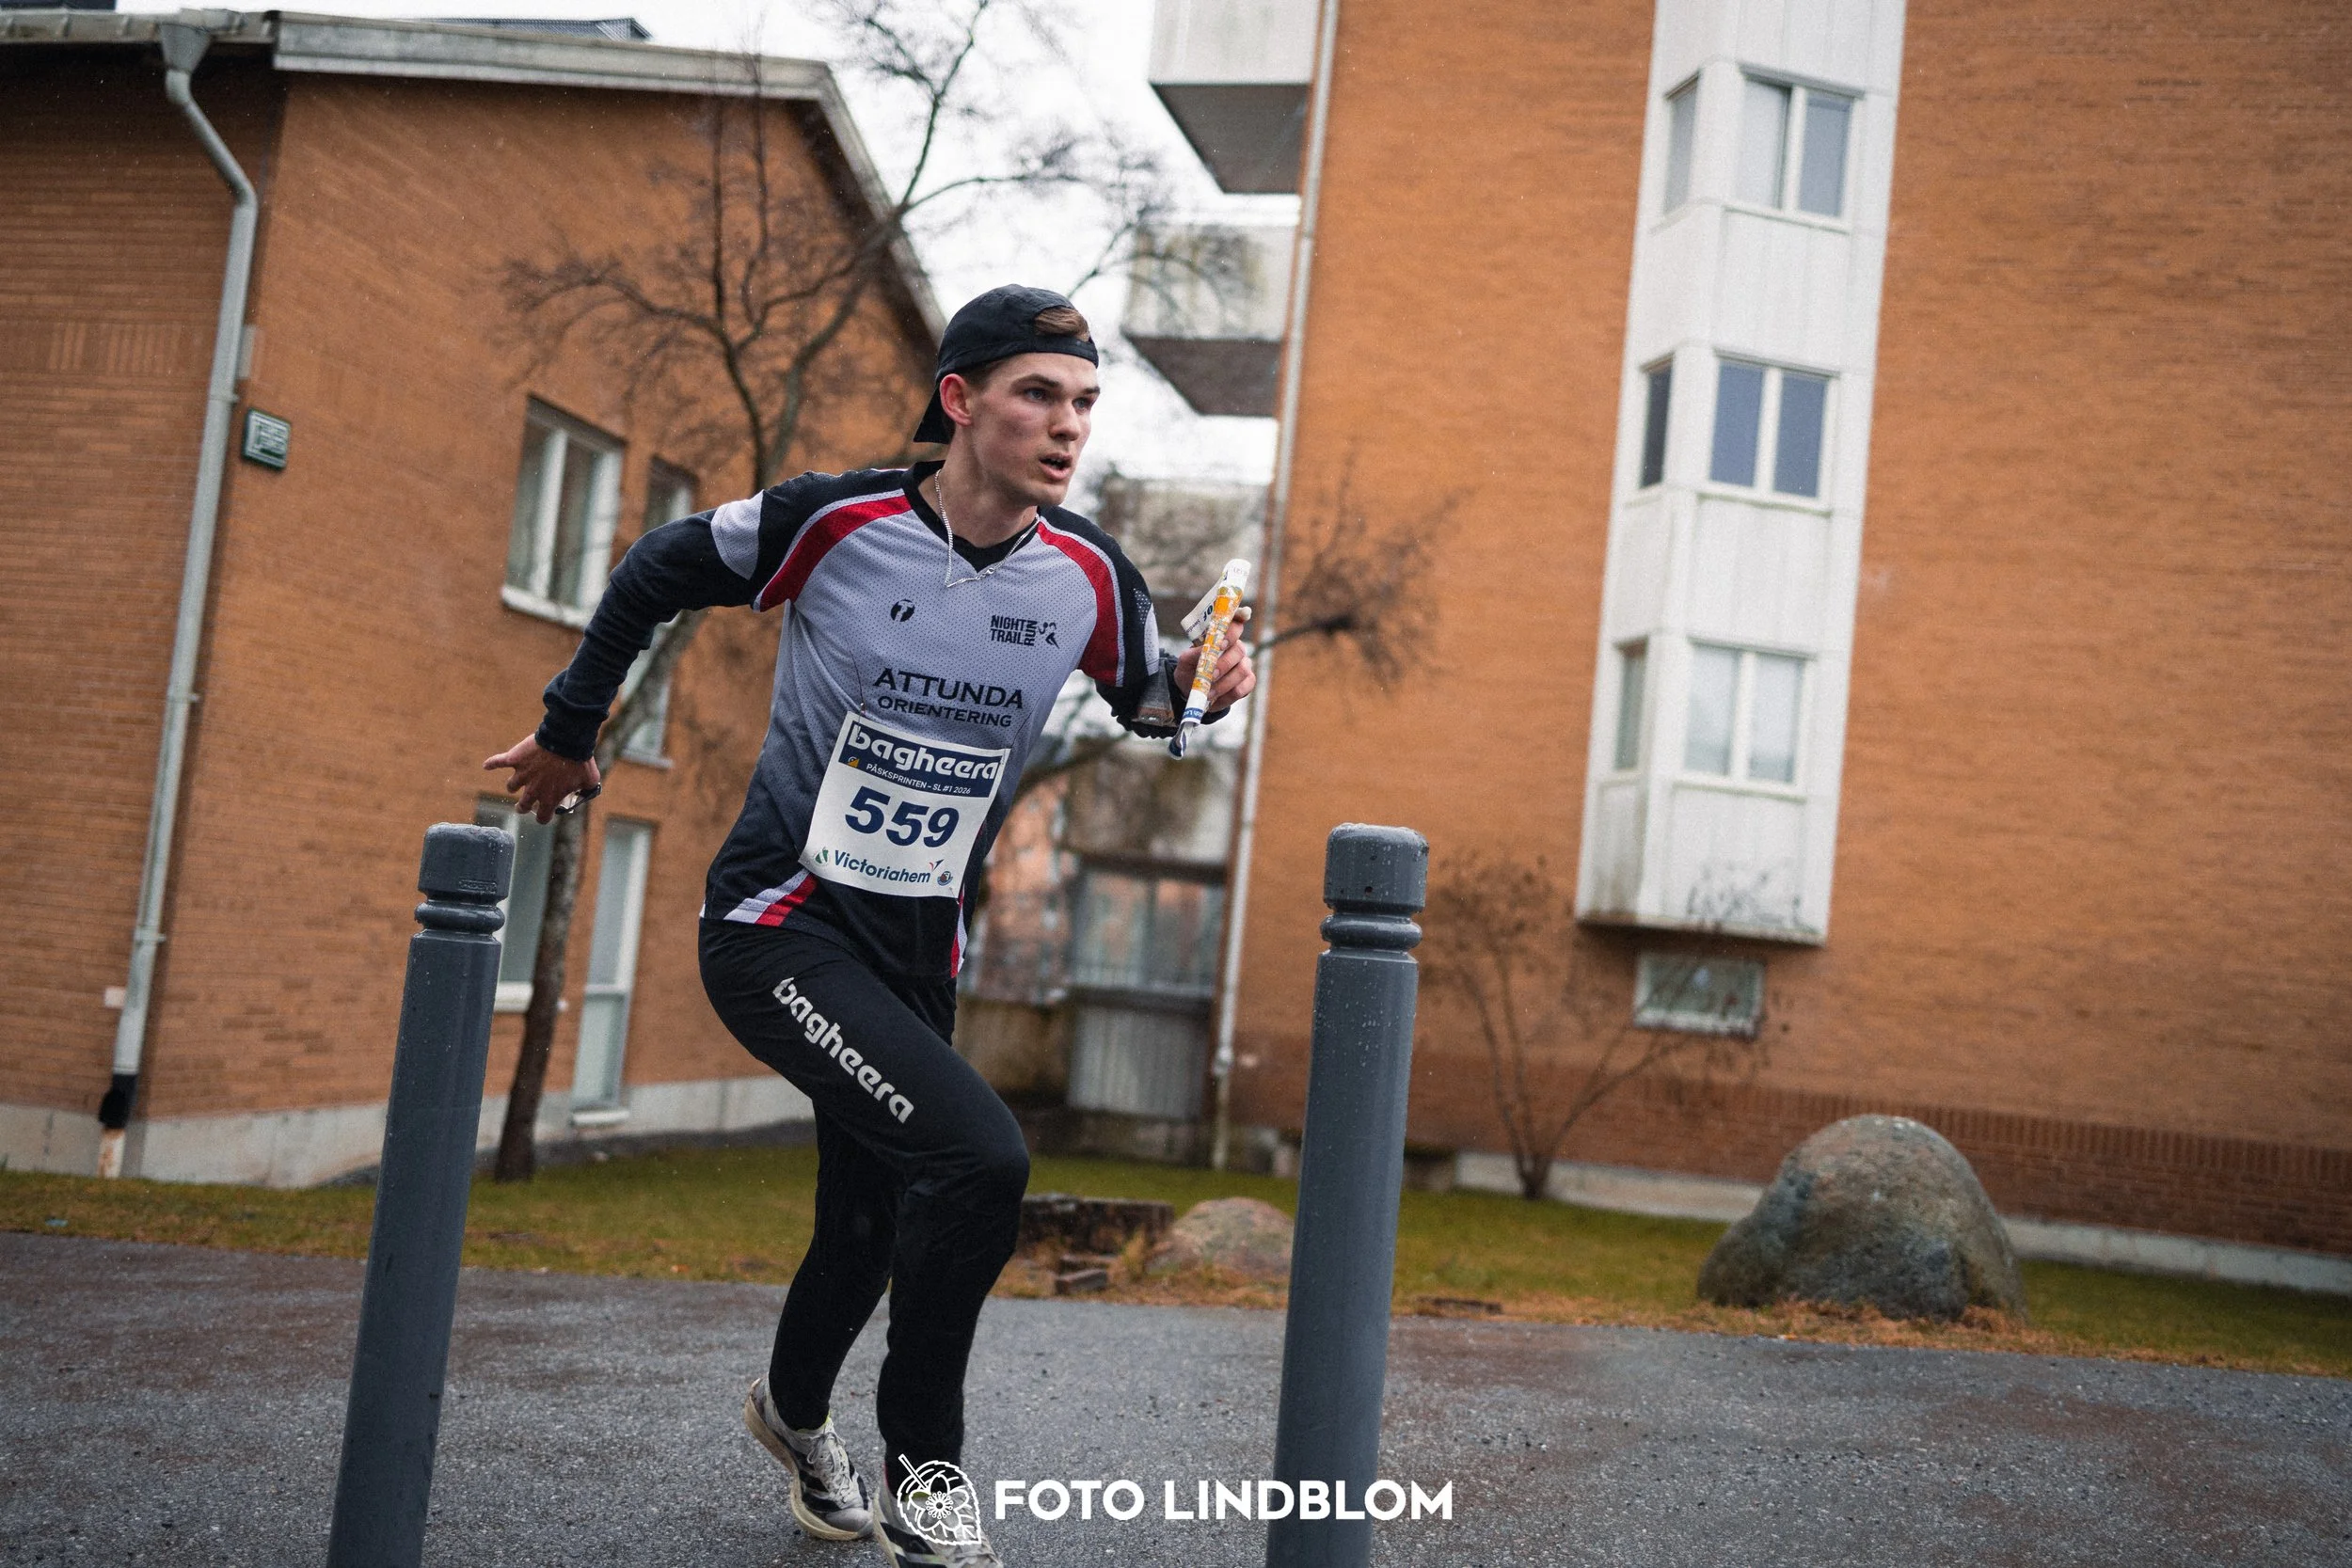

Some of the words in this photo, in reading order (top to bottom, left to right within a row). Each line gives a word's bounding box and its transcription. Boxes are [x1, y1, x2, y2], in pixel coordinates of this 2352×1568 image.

[990, 628, 1024, 645] TRAIL
[991, 614, 1026, 631] NIGHT
[1024, 620, 1038, 646] RUN
[873, 668, 1024, 709] ATTUNDA
[878, 695, 1012, 728] ORIENTERING
[848, 723, 1000, 780] bagheera
[866, 763, 928, 789] PÅSKSPRINTEN
[932, 784, 942, 792] SL
[943, 785, 953, 794] #1
[953, 786, 972, 795] 2026
[845, 786, 960, 847] 559
[834, 849, 931, 883] Victoriahem
[772, 976, 914, 1124] bagheera
